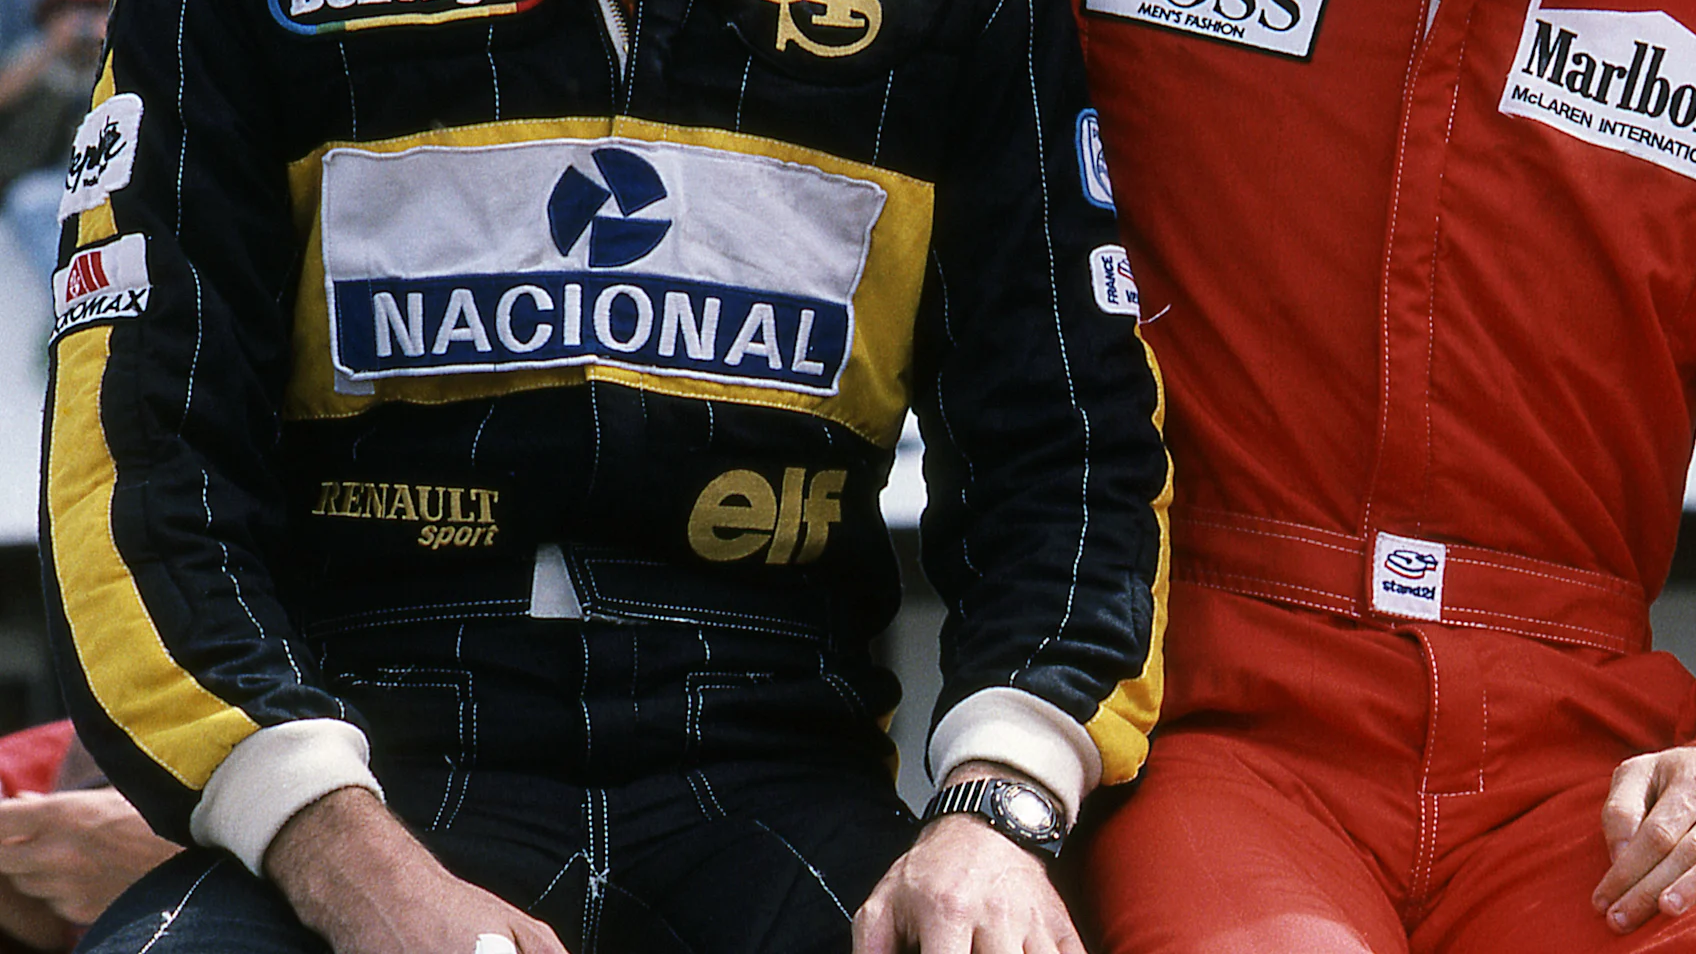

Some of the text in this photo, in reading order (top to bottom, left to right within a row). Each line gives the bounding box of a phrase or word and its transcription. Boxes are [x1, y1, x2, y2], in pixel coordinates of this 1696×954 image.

[1137, 2, 1245, 39] MEN'S FASHION
[1512, 85, 1592, 128] McLAREN
[1101, 255, 1119, 305] FRANCE
[373, 284, 828, 376] NACIONAL
[312, 481, 498, 523] RENAULT
[688, 467, 847, 564] elf
[417, 522, 498, 550] sport
